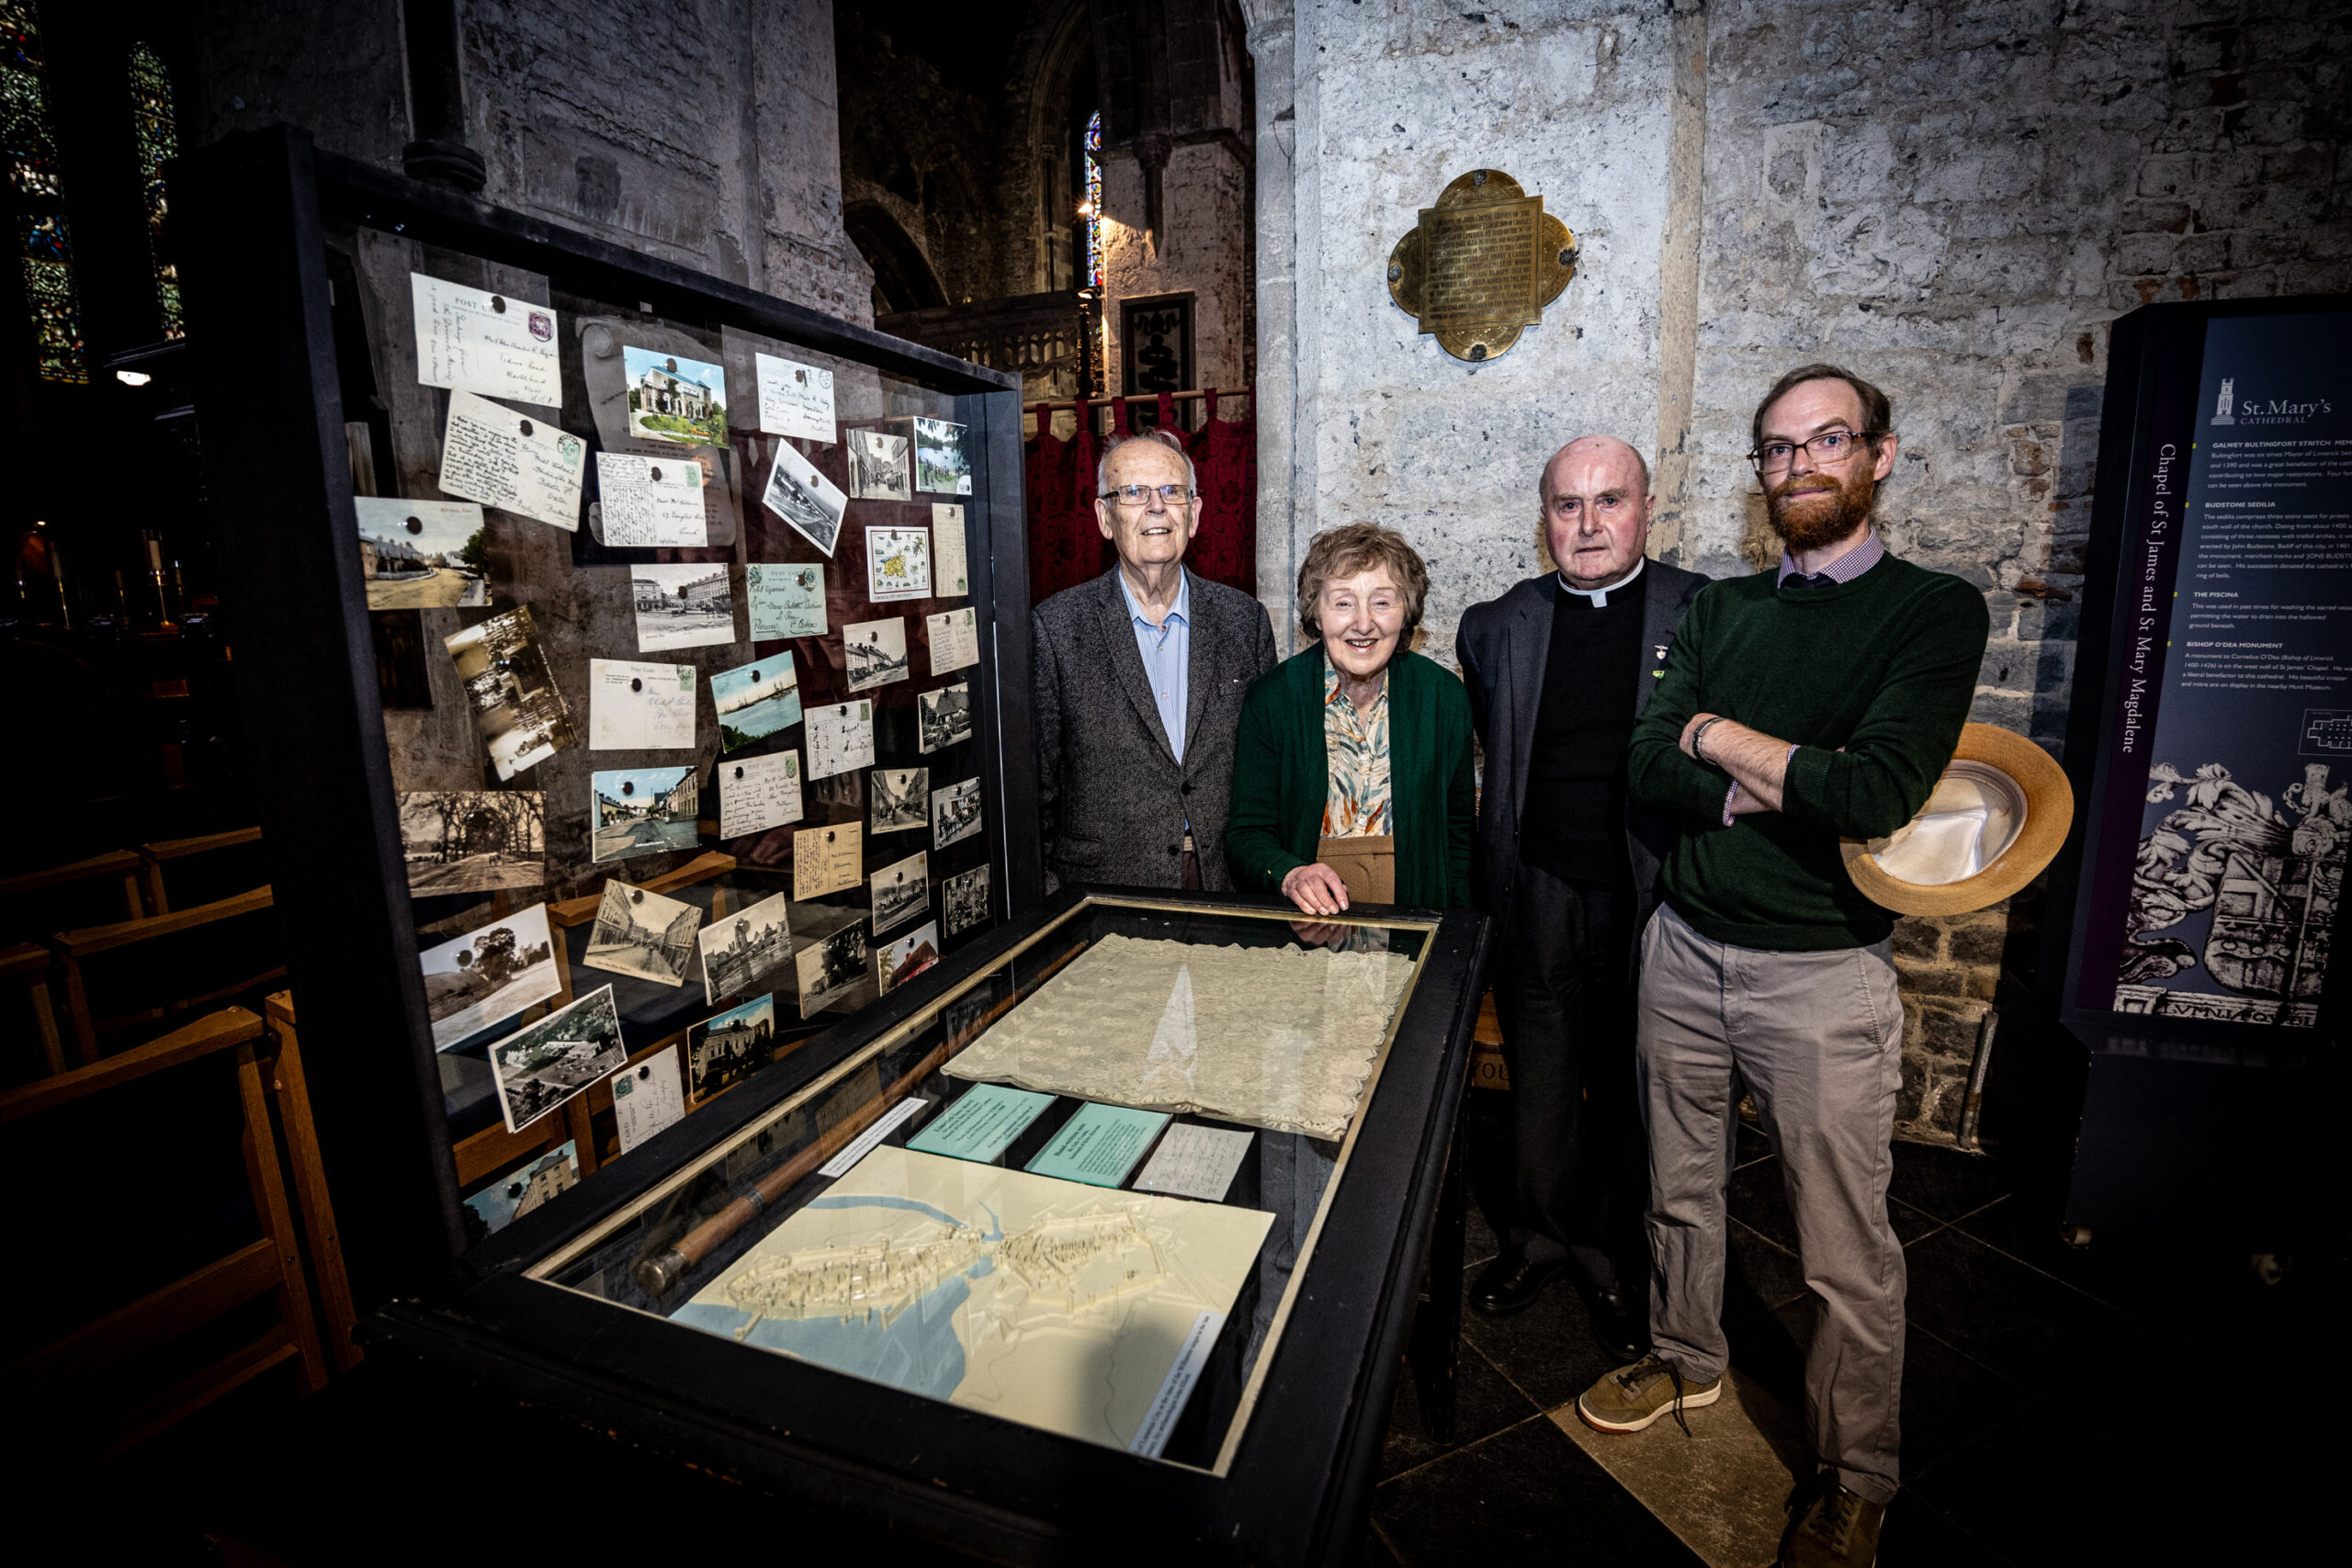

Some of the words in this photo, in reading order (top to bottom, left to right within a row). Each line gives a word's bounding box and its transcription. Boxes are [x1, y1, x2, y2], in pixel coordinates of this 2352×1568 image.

[456, 298, 476, 309] POST
[2242, 400, 2264, 415] St.
[2268, 399, 2331, 417] Mary's
[2240, 416, 2305, 424] CATHEDRAL
[2153, 444, 2176, 494] Chapel
[2154, 501, 2168, 517] of
[2152, 521, 2166, 535] St
[2146, 539, 2164, 581] James
[2142, 586, 2156, 612] and
[2140, 616, 2154, 631] St
[2130, 636, 2151, 673] Mary
[2123, 679, 2147, 753] Magdalene
[624, 1122, 632, 1144] CARD
